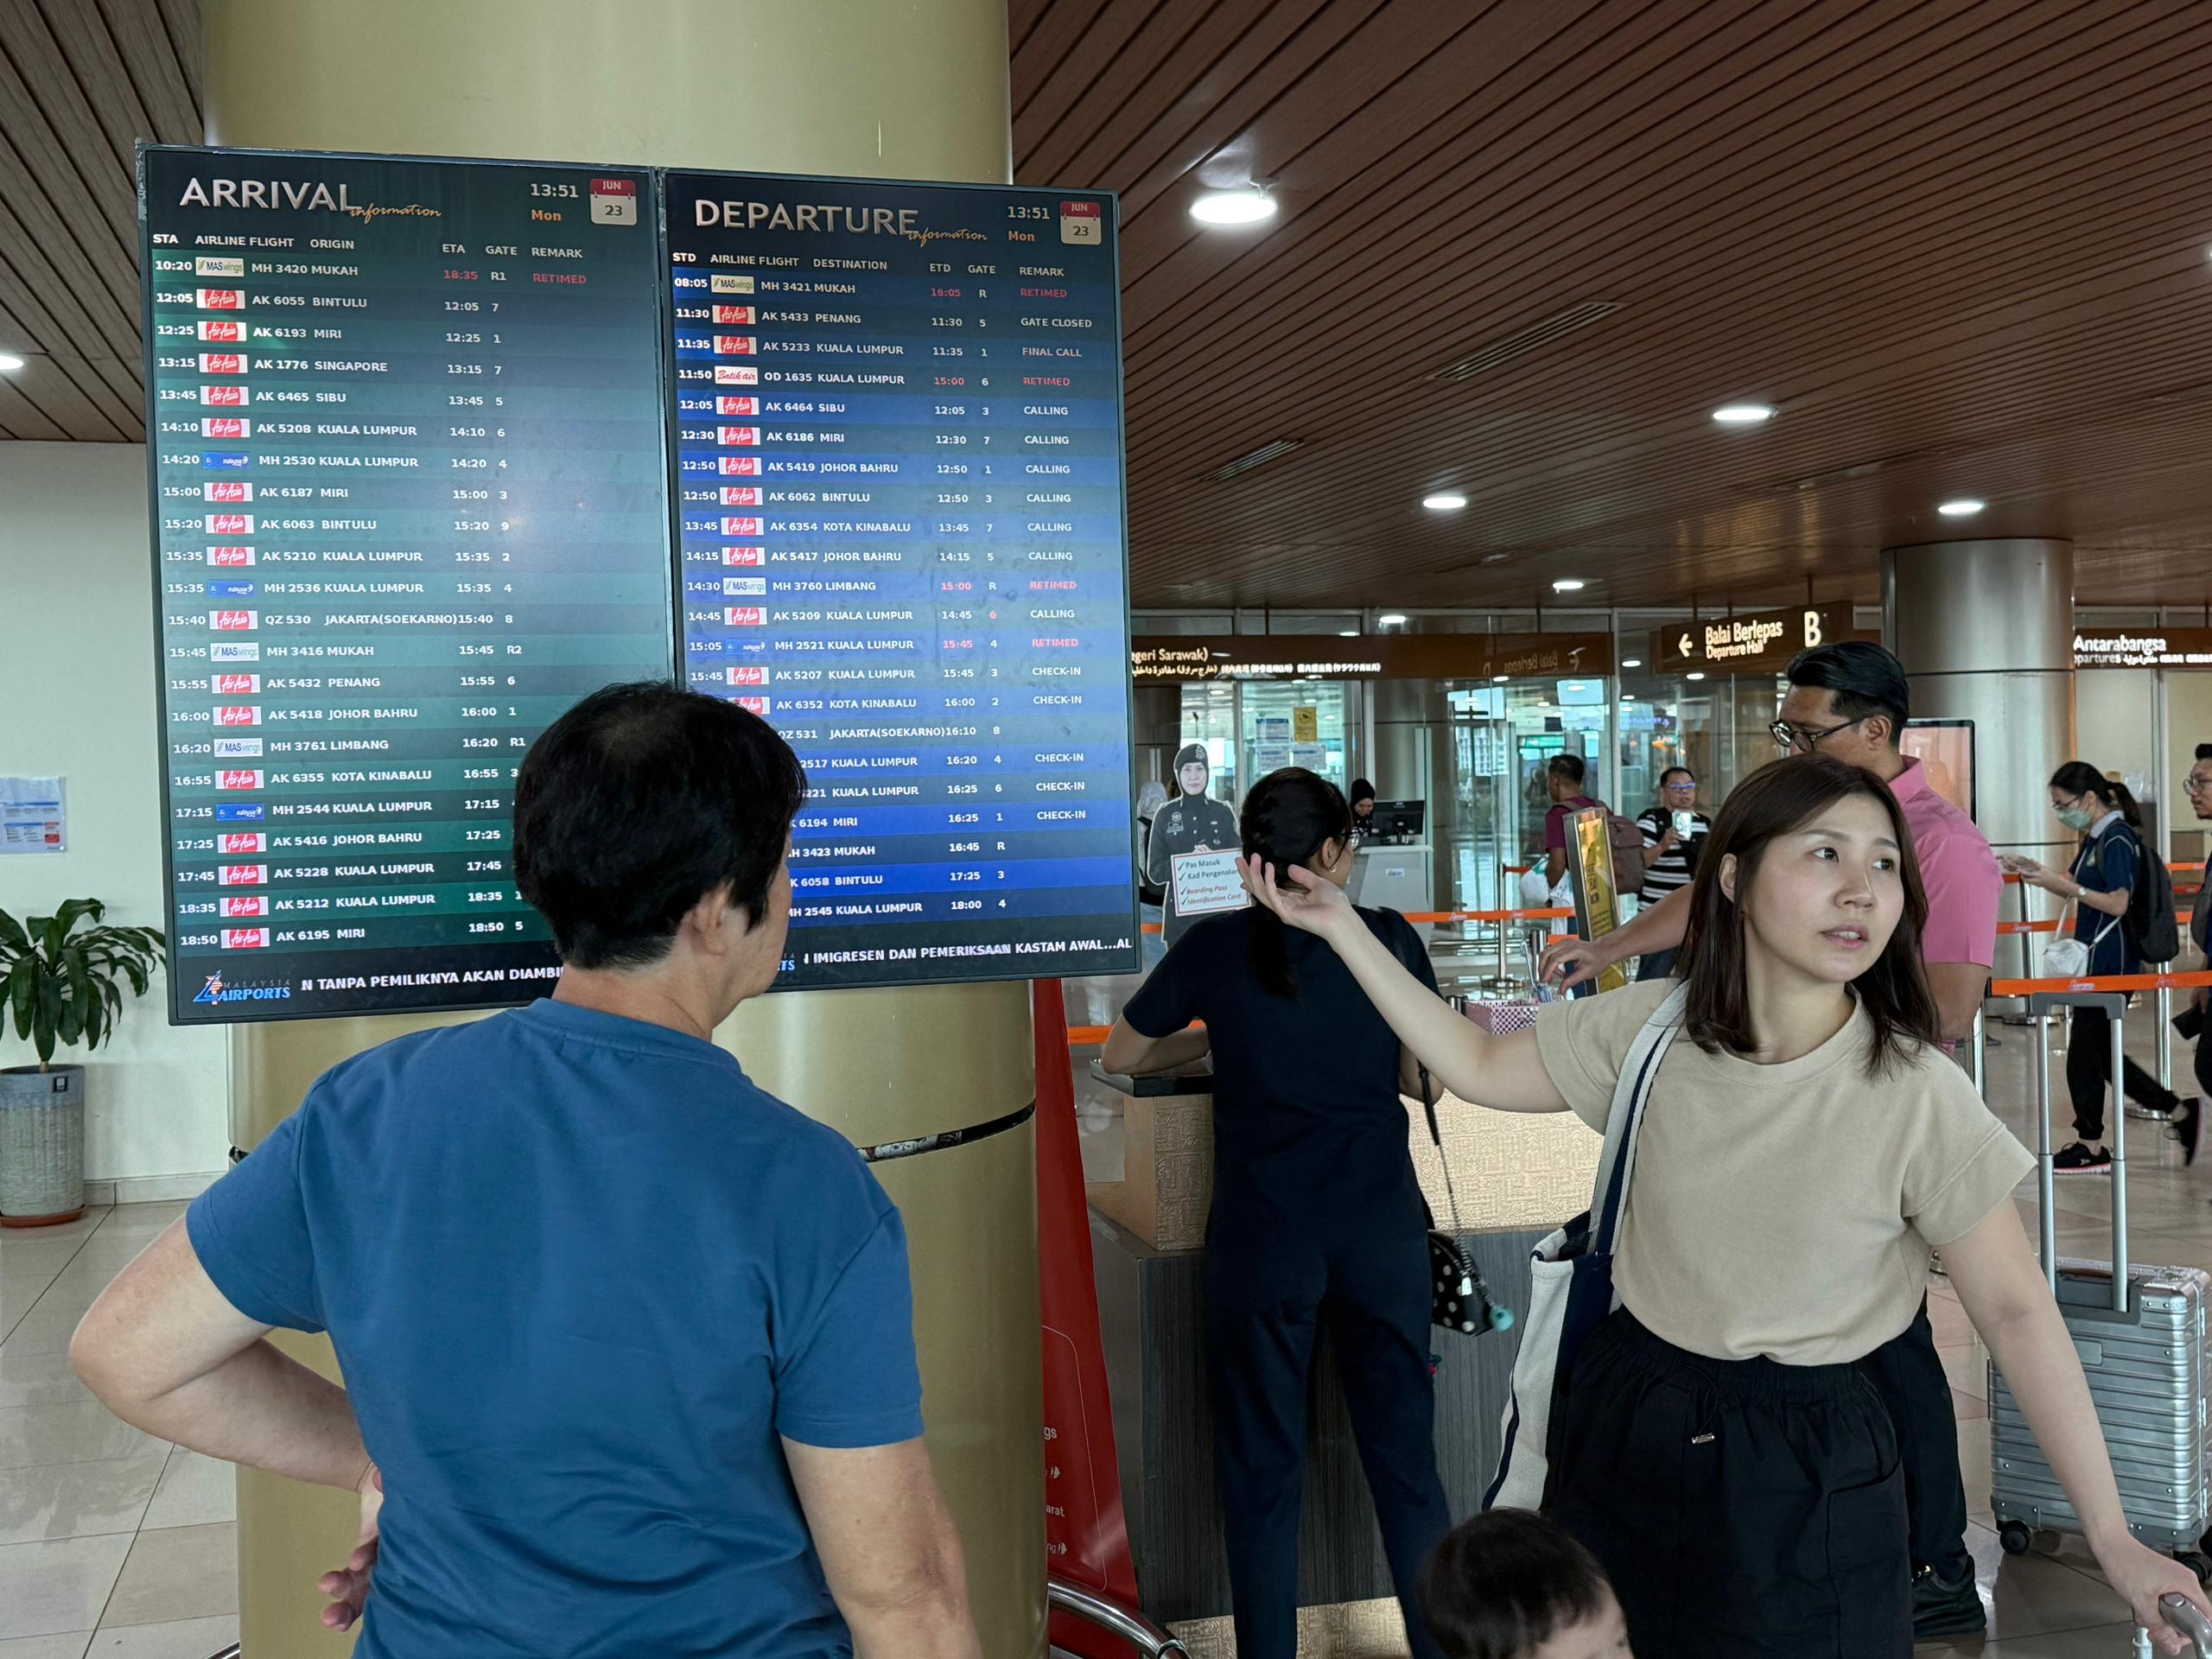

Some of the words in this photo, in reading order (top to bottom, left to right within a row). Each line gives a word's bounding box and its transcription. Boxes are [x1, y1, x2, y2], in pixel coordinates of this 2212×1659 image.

[531, 183, 579, 198] 13:51
[602, 181, 622, 190] JUN
[179, 177, 362, 211] ARRIVAL
[349, 202, 442, 225] information
[1071, 203, 1088, 213] JUN
[531, 209, 562, 221] Mon
[605, 205, 622, 216] 23
[1007, 206, 1050, 219] 13:51
[696, 199, 918, 236] DEPARTURE
[907, 227, 988, 248] information
[1072, 226, 1089, 237] 23
[1008, 231, 1035, 242] Mon
[152, 233, 179, 244] STA
[194, 235, 246, 245] AIRLINE
[249, 237, 295, 247] FLIGHT
[309, 238, 354, 249] ORIGIN
[442, 244, 466, 253] ETA
[485, 245, 518, 255] GATE
[531, 247, 582, 258] REMARK
[155, 260, 193, 270] 10:20
[251, 263, 272, 273] MH
[275, 264, 308, 274] 3420
[310, 264, 358, 276] MUKAH
[443, 270, 478, 280] 18:35
[490, 270, 506, 281] R1
[532, 272, 587, 283] RETIMED
[671, 251, 696, 262] STD
[709, 253, 755, 264] AIRLINE
[759, 256, 799, 266] FLIGHT
[813, 257, 887, 270] DESTINATION
[930, 263, 950, 272] ETD
[967, 264, 995, 274] GATE
[1019, 266, 1065, 276] REMARK
[674, 278, 708, 288] 08:05
[760, 281, 779, 290] MH
[782, 282, 811, 291] 3421
[814, 283, 855, 293] MUKAH
[931, 287, 961, 296] 16:05
[978, 289, 987, 298] R
[1020, 288, 1067, 298] RETIMED
[676, 308, 709, 318] 11:30
[761, 311, 778, 321] AK
[780, 312, 809, 321] 5433
[815, 313, 861, 323] PENANG
[931, 317, 963, 327] 11:30
[979, 318, 986, 327] 5
[1020, 317, 1048, 327] GATE
[1051, 318, 1092, 327] CLOSED
[158, 357, 195, 367] 13:15
[253, 359, 273, 369] AK
[276, 359, 308, 370] 1776
[314, 360, 388, 372] SINGAPORE
[447, 364, 482, 374] 13:15
[493, 365, 501, 375] 7
[678, 369, 712, 379] 11:50
[764, 372, 781, 381] OD
[784, 372, 812, 382] 1635
[817, 373, 855, 383] KUALA
[857, 373, 905, 385] LUMPUR
[934, 377, 964, 385] 15:00
[982, 377, 988, 386] 6
[1023, 377, 1071, 386] RETIMED
[162, 454, 200, 464] 14:20
[258, 455, 280, 465] MH
[283, 455, 315, 466] 2530
[319, 456, 361, 467] KUALA
[364, 456, 418, 467] LUMPUR
[450, 458, 486, 468] 14:20
[498, 459, 507, 468] 4
[684, 520, 718, 531] 13:45
[769, 522, 787, 531] AK
[788, 522, 818, 531] 6354
[823, 522, 853, 531] KOTA
[855, 522, 911, 531] KINABALU
[938, 523, 969, 531] 13:45
[986, 523, 993, 532] 7
[1027, 522, 1072, 531] CALLING
[1705, 625, 1732, 645] Balai
[1732, 620, 1783, 644] Berlepas
[1804, 611, 1821, 648] B
[1706, 644, 1746, 661] Departure
[1746, 639, 1764, 654] Hall
[2073, 633, 2167, 656] Antarabangsa
[1159, 646, 1209, 662] Sarawak)
[690, 671, 723, 682] 15:45
[774, 671, 792, 680] AK
[793, 670, 822, 680] 5207
[828, 670, 865, 679] KUALA
[868, 669, 915, 679] LUMPUR
[944, 668, 974, 677] 15:45
[990, 668, 997, 677] 3
[1032, 666, 1081, 676] CHECK-IN
[171, 679, 207, 690] 15:55
[266, 678, 287, 689] AK
[288, 678, 321, 688] 5432
[327, 677, 380, 688] PENANG
[460, 676, 495, 686] 15:55
[506, 676, 515, 685] 6
[172, 711, 210, 721] 16:00
[268, 709, 288, 720] AK
[289, 709, 323, 719] 5418
[327, 709, 371, 721] JOHOR
[373, 708, 417, 718] BAHRU
[461, 707, 497, 716] 16:00
[508, 707, 517, 715] 1
[1198, 859, 1220, 868] Masuk
[1187, 871, 1200, 880] Kad
[1186, 886, 1213, 895] Boarding
[804, 906, 832, 916] 2545
[835, 904, 873, 915] KUALA
[874, 902, 923, 913] LUMPUR
[950, 899, 982, 910] 18:00
[998, 899, 1007, 908] 4
[180, 934, 218, 946] 18:50
[276, 931, 296, 942] AK
[297, 929, 330, 940] 6195
[336, 928, 365, 938] MIRI
[468, 921, 505, 932] 18:50
[514, 920, 524, 931] 5
[813, 949, 885, 963] IMIGRESEN
[888, 947, 917, 960] DAN
[920, 943, 1011, 958] PEMERIKSAAN
[1014, 940, 1065, 954] KASTAM
[223, 978, 291, 989] MALAYSIA
[316, 976, 366, 990] TANPA
[370, 971, 460, 988] PEMILIKNYA
[461, 969, 505, 982] AKAN
[217, 987, 291, 1001] AIRPORTS
